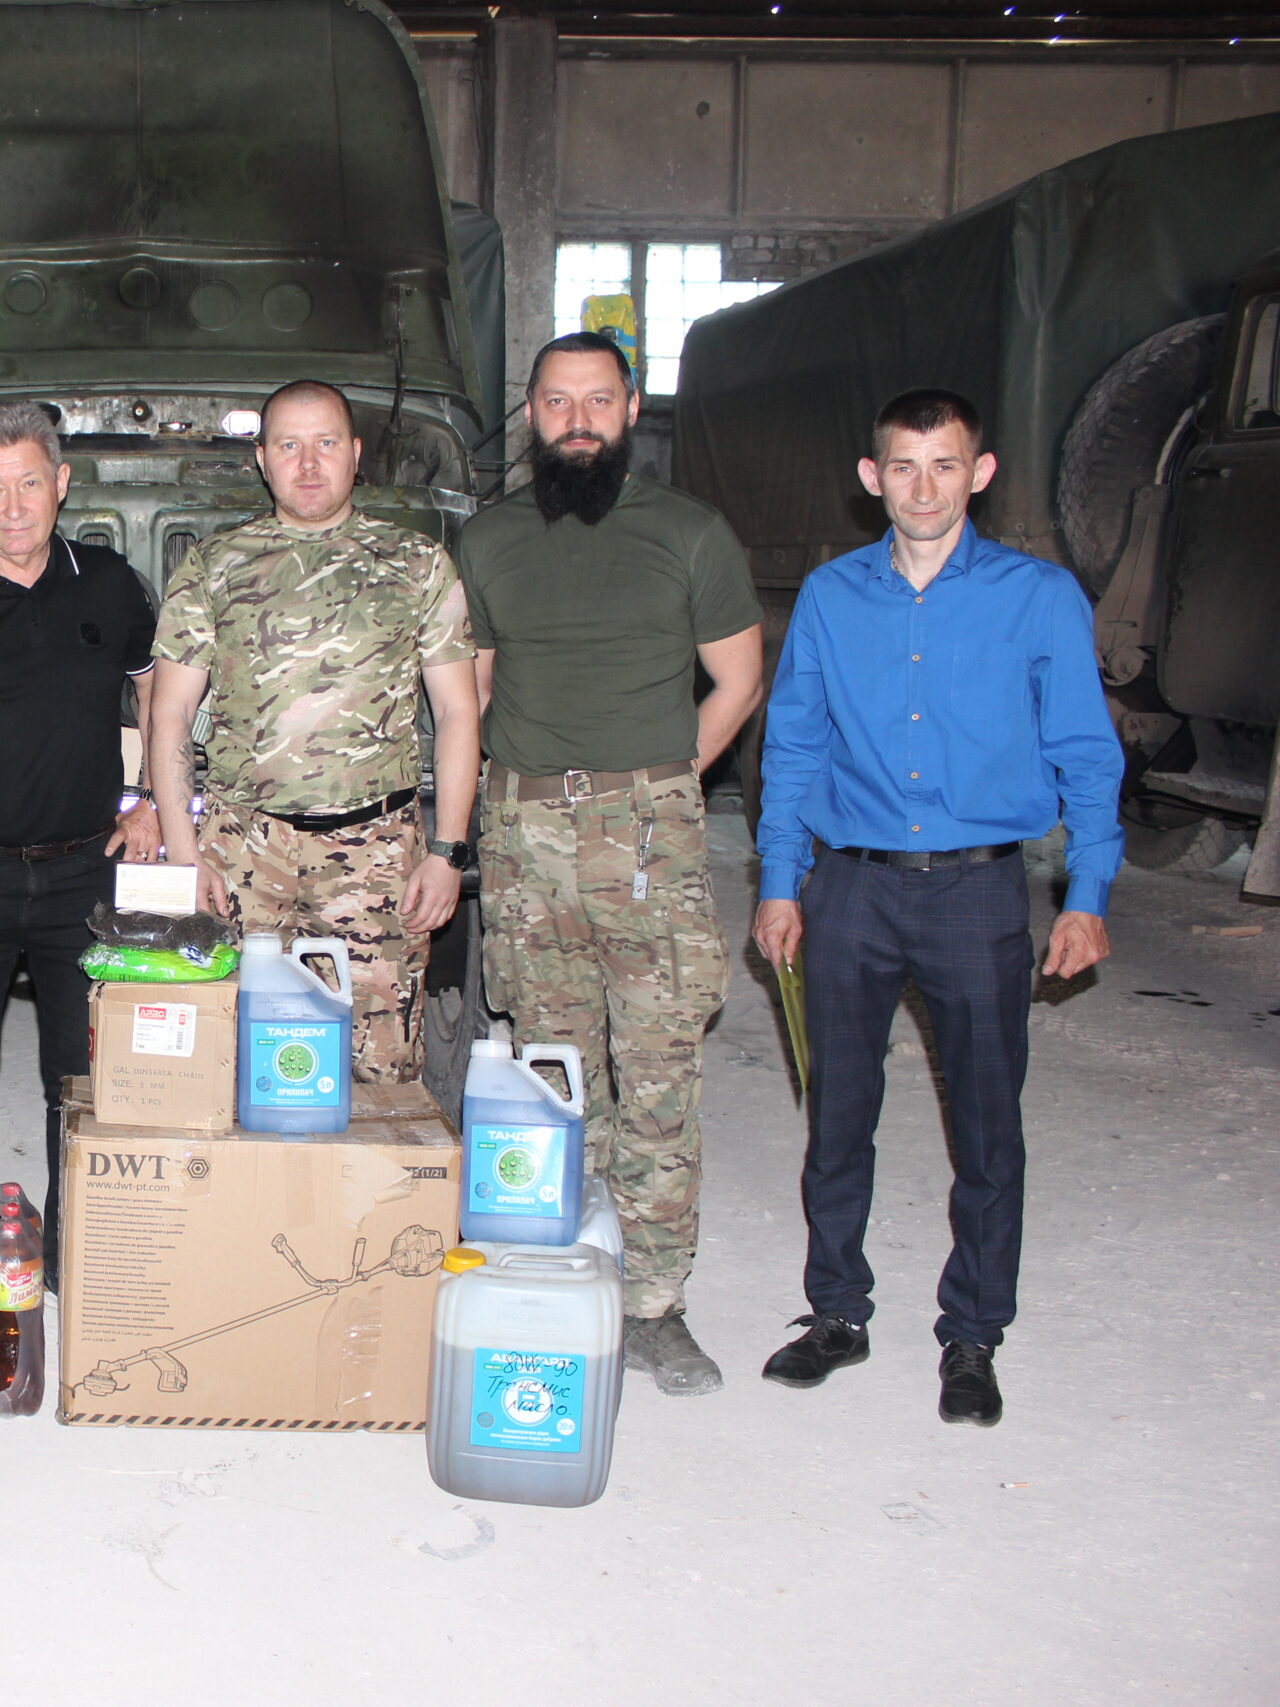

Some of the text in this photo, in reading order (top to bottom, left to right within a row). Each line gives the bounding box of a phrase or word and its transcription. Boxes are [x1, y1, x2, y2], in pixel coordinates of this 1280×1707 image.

[265, 1027, 327, 1038] ТАНДЕМ
[178, 1071, 205, 1080] CHAIN
[111, 1079, 134, 1088] SIZE:
[277, 1088, 314, 1096] ПРИЛИПАЧ
[86, 1152, 170, 1180] DWT
[421, 1168, 443, 1178] (1/2)
[86, 1180, 170, 1192] www.dwt-pt.com
